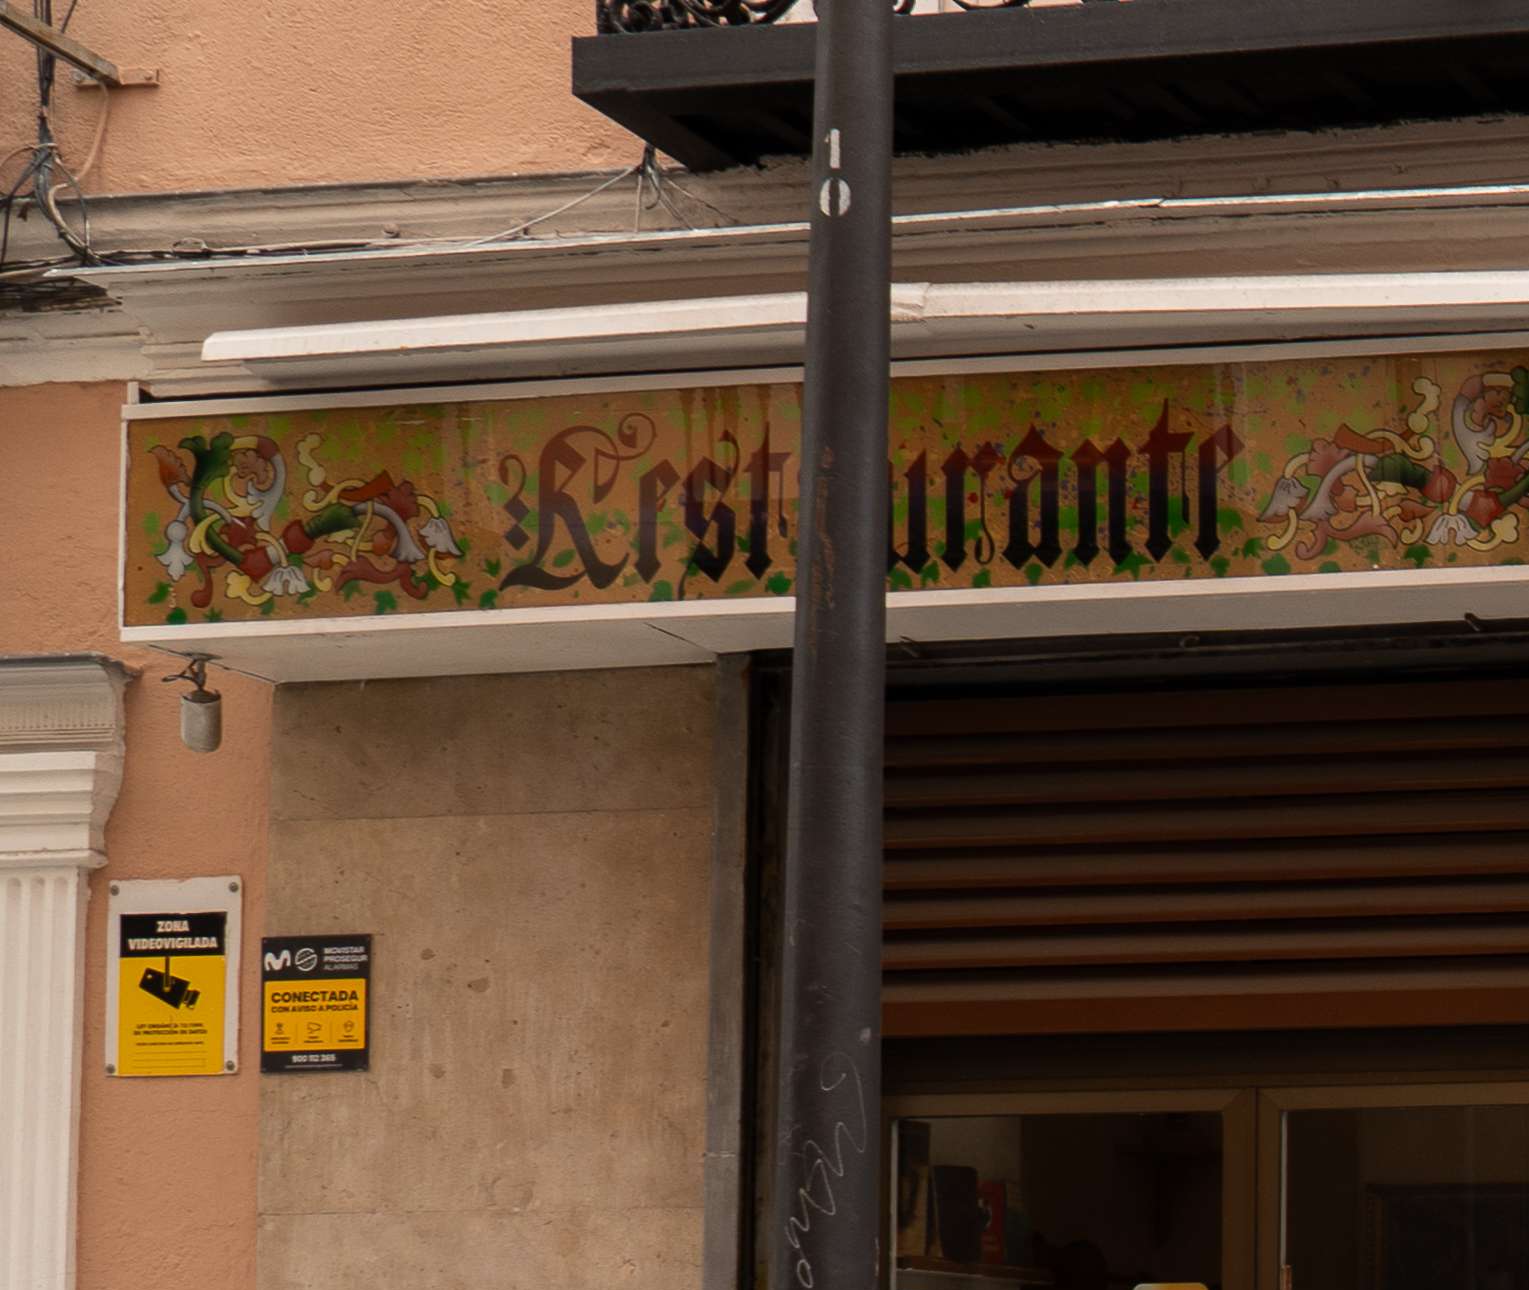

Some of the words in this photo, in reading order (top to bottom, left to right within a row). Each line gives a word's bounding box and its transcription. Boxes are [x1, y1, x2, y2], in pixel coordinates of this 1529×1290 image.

[498, 398, 1245, 598] Resturante
[156, 920, 190, 933] ZONA
[127, 936, 218, 950] VIDEOVIGILADA
[271, 990, 358, 1003] CONECTADA
